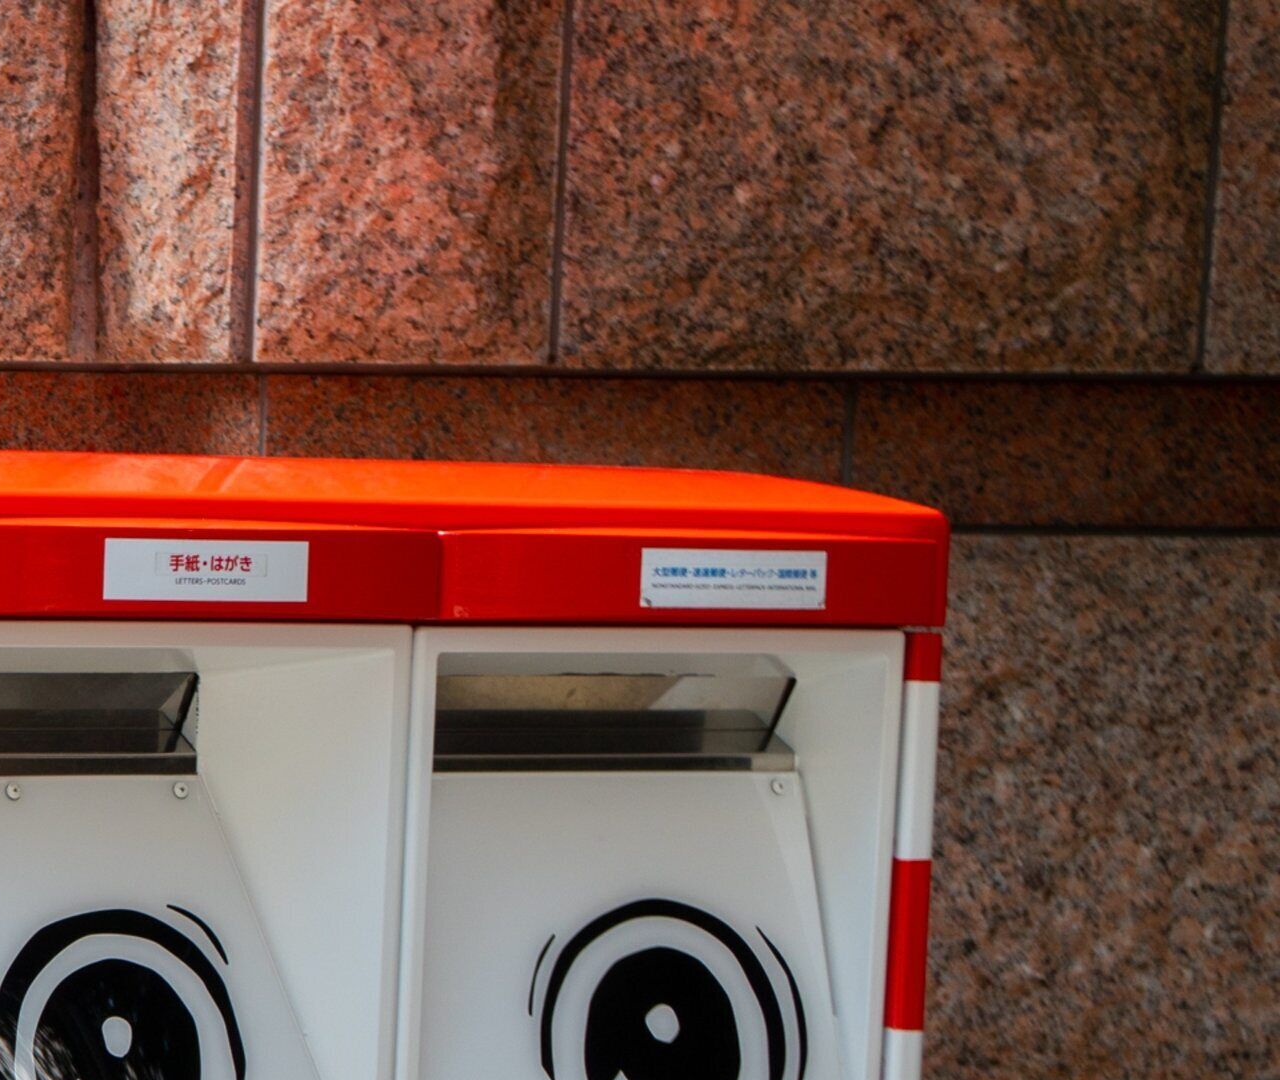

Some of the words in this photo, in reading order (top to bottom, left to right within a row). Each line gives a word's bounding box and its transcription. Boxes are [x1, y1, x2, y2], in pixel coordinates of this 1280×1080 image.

[169, 554, 252, 572] 手紙・はがき
